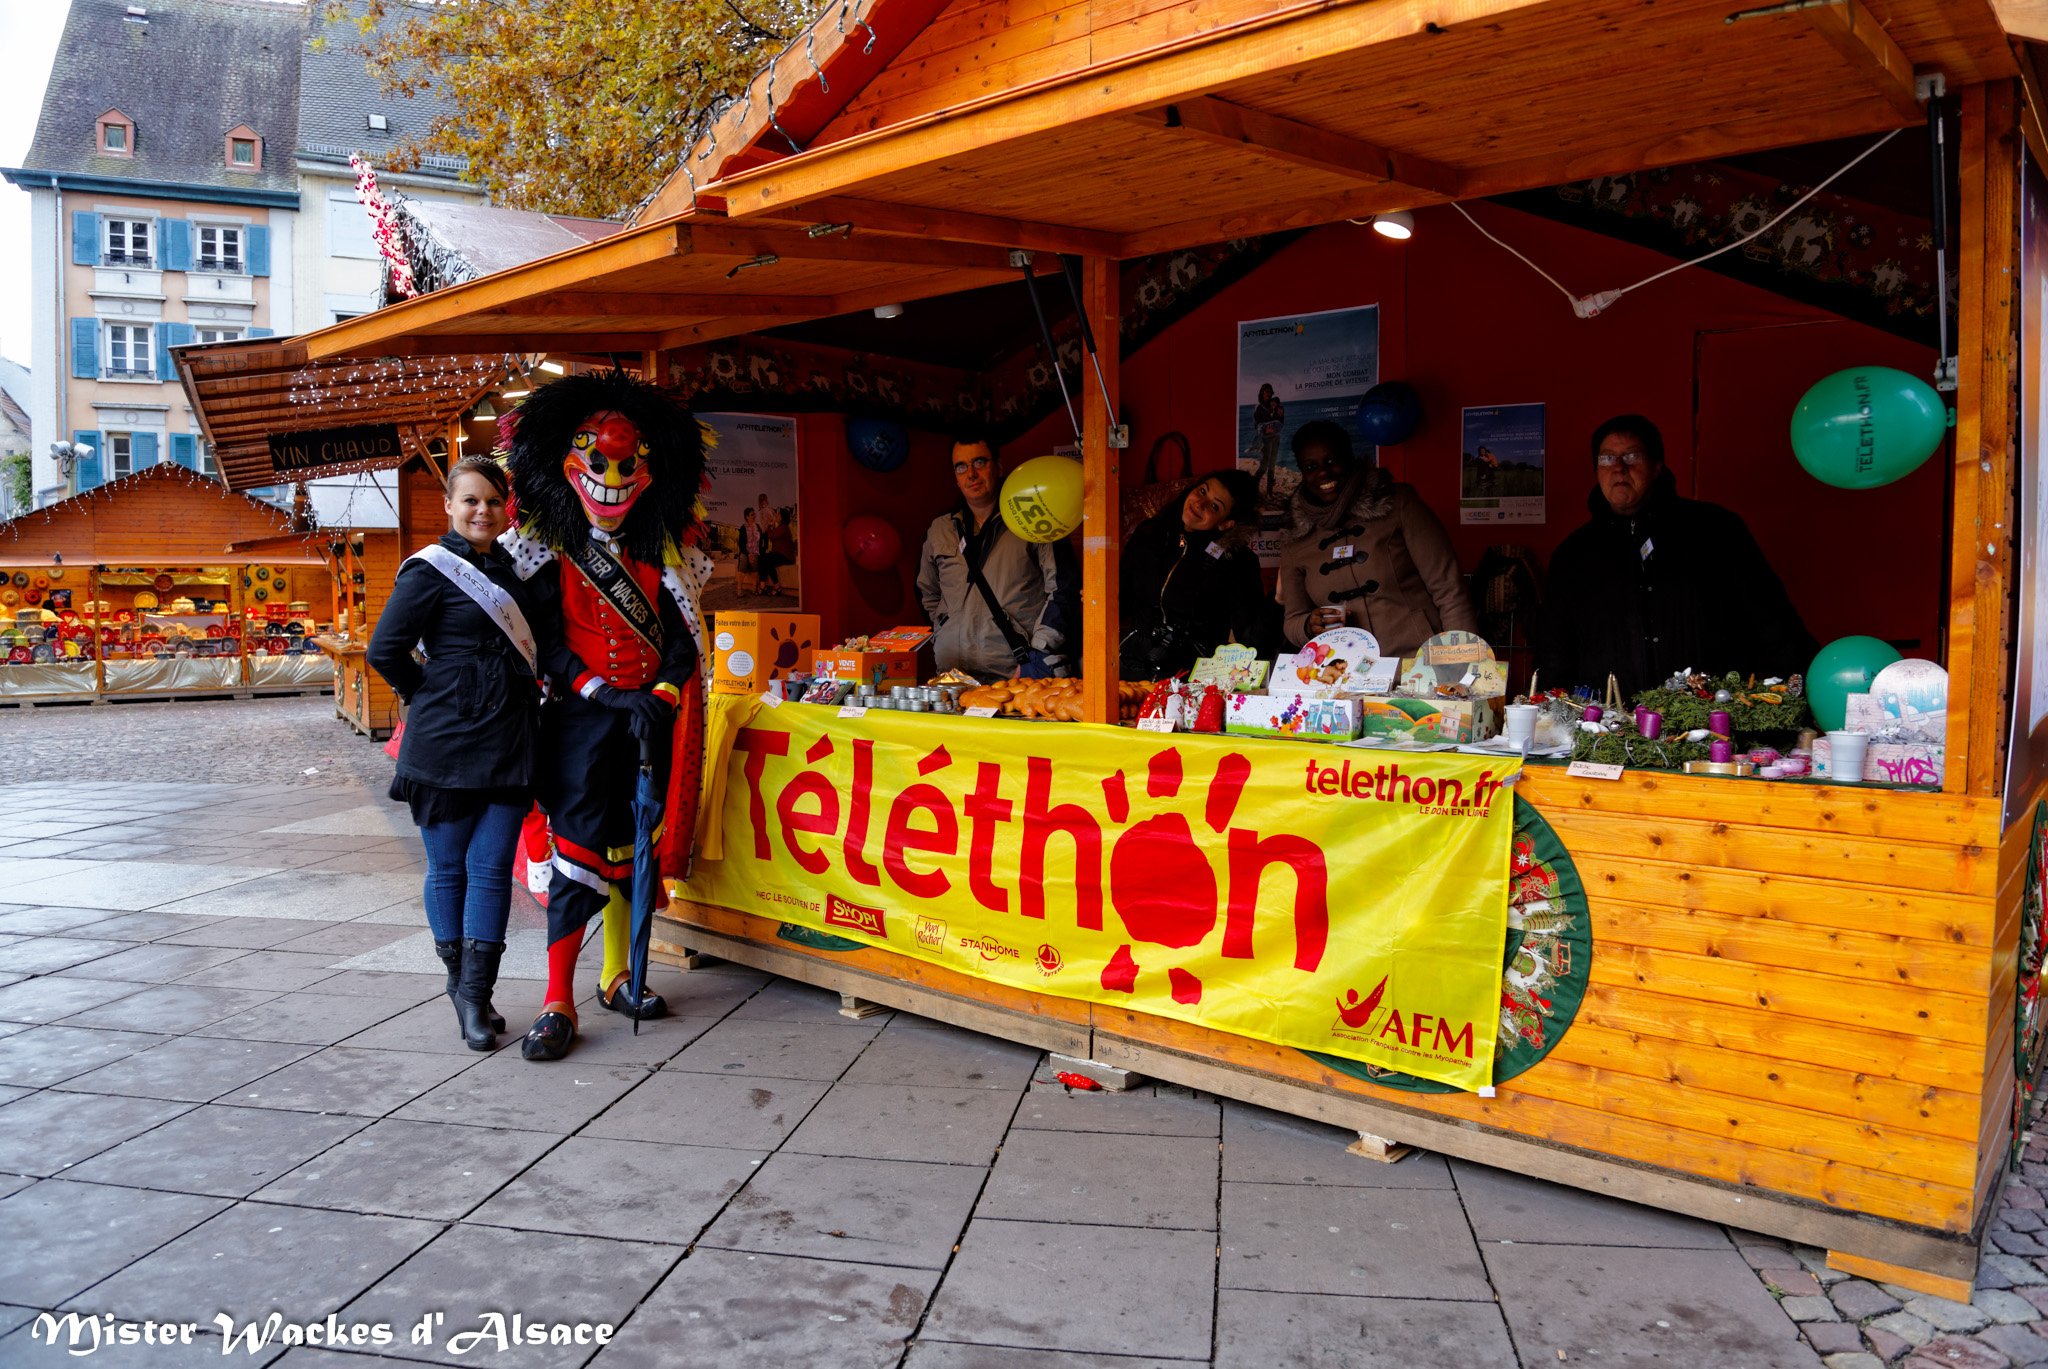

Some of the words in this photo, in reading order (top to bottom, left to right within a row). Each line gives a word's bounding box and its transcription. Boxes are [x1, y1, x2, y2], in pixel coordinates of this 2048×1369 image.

[1243, 326, 1294, 338] AFMTELETHON
[1326, 371, 1341, 379] MON
[1343, 369, 1369, 377] COMBAT
[1304, 380, 1333, 388] PRENDRE
[1335, 378, 1343, 386] DE
[736, 423, 782, 433] AFMTELETHON
[1854, 376, 1874, 472] TELETHON.FR
[274, 444, 310, 466] VIN
[321, 438, 391, 461] CHAUD
[1007, 499, 1017, 514] DON
[1013, 495, 1067, 542] 3637
[1014, 515, 1024, 526] DU
[584, 541, 612, 578] ISTER
[609, 578, 649, 624] WACKES
[462, 572, 515, 632] DAUPHINE
[1332, 635, 1348, 644] 3€
[520, 639, 536, 661] MISS
[1223, 650, 1255, 664] LIBERTY
[839, 659, 856, 667] VENTE
[1483, 670, 1494, 681] 4€
[1306, 759, 1504, 807] telethon.fr
[1419, 806, 1429, 815] LE
[1430, 807, 1449, 816] DON
[1451, 808, 1465, 816] EN
[1467, 808, 1489, 818] LIGNE
[732, 728, 1330, 974] Téléthon
[773, 893, 782, 902] LE
[809, 902, 821, 912] DE
[833, 899, 879, 928] SHOPI
[924, 921, 941, 935] Yves
[917, 930, 942, 946] Rocher
[960, 938, 1020, 958] STANHOME
[1034, 957, 1043, 973] PETIT
[1379, 1009, 1474, 1059] AFM
[1331, 1032, 1369, 1043] Association
[1370, 1038, 1400, 1051] Française
[1401, 1047, 1422, 1057] contre
[1422, 1050, 1433, 1059] les
[1434, 1053, 1472, 1069] Myopathies
